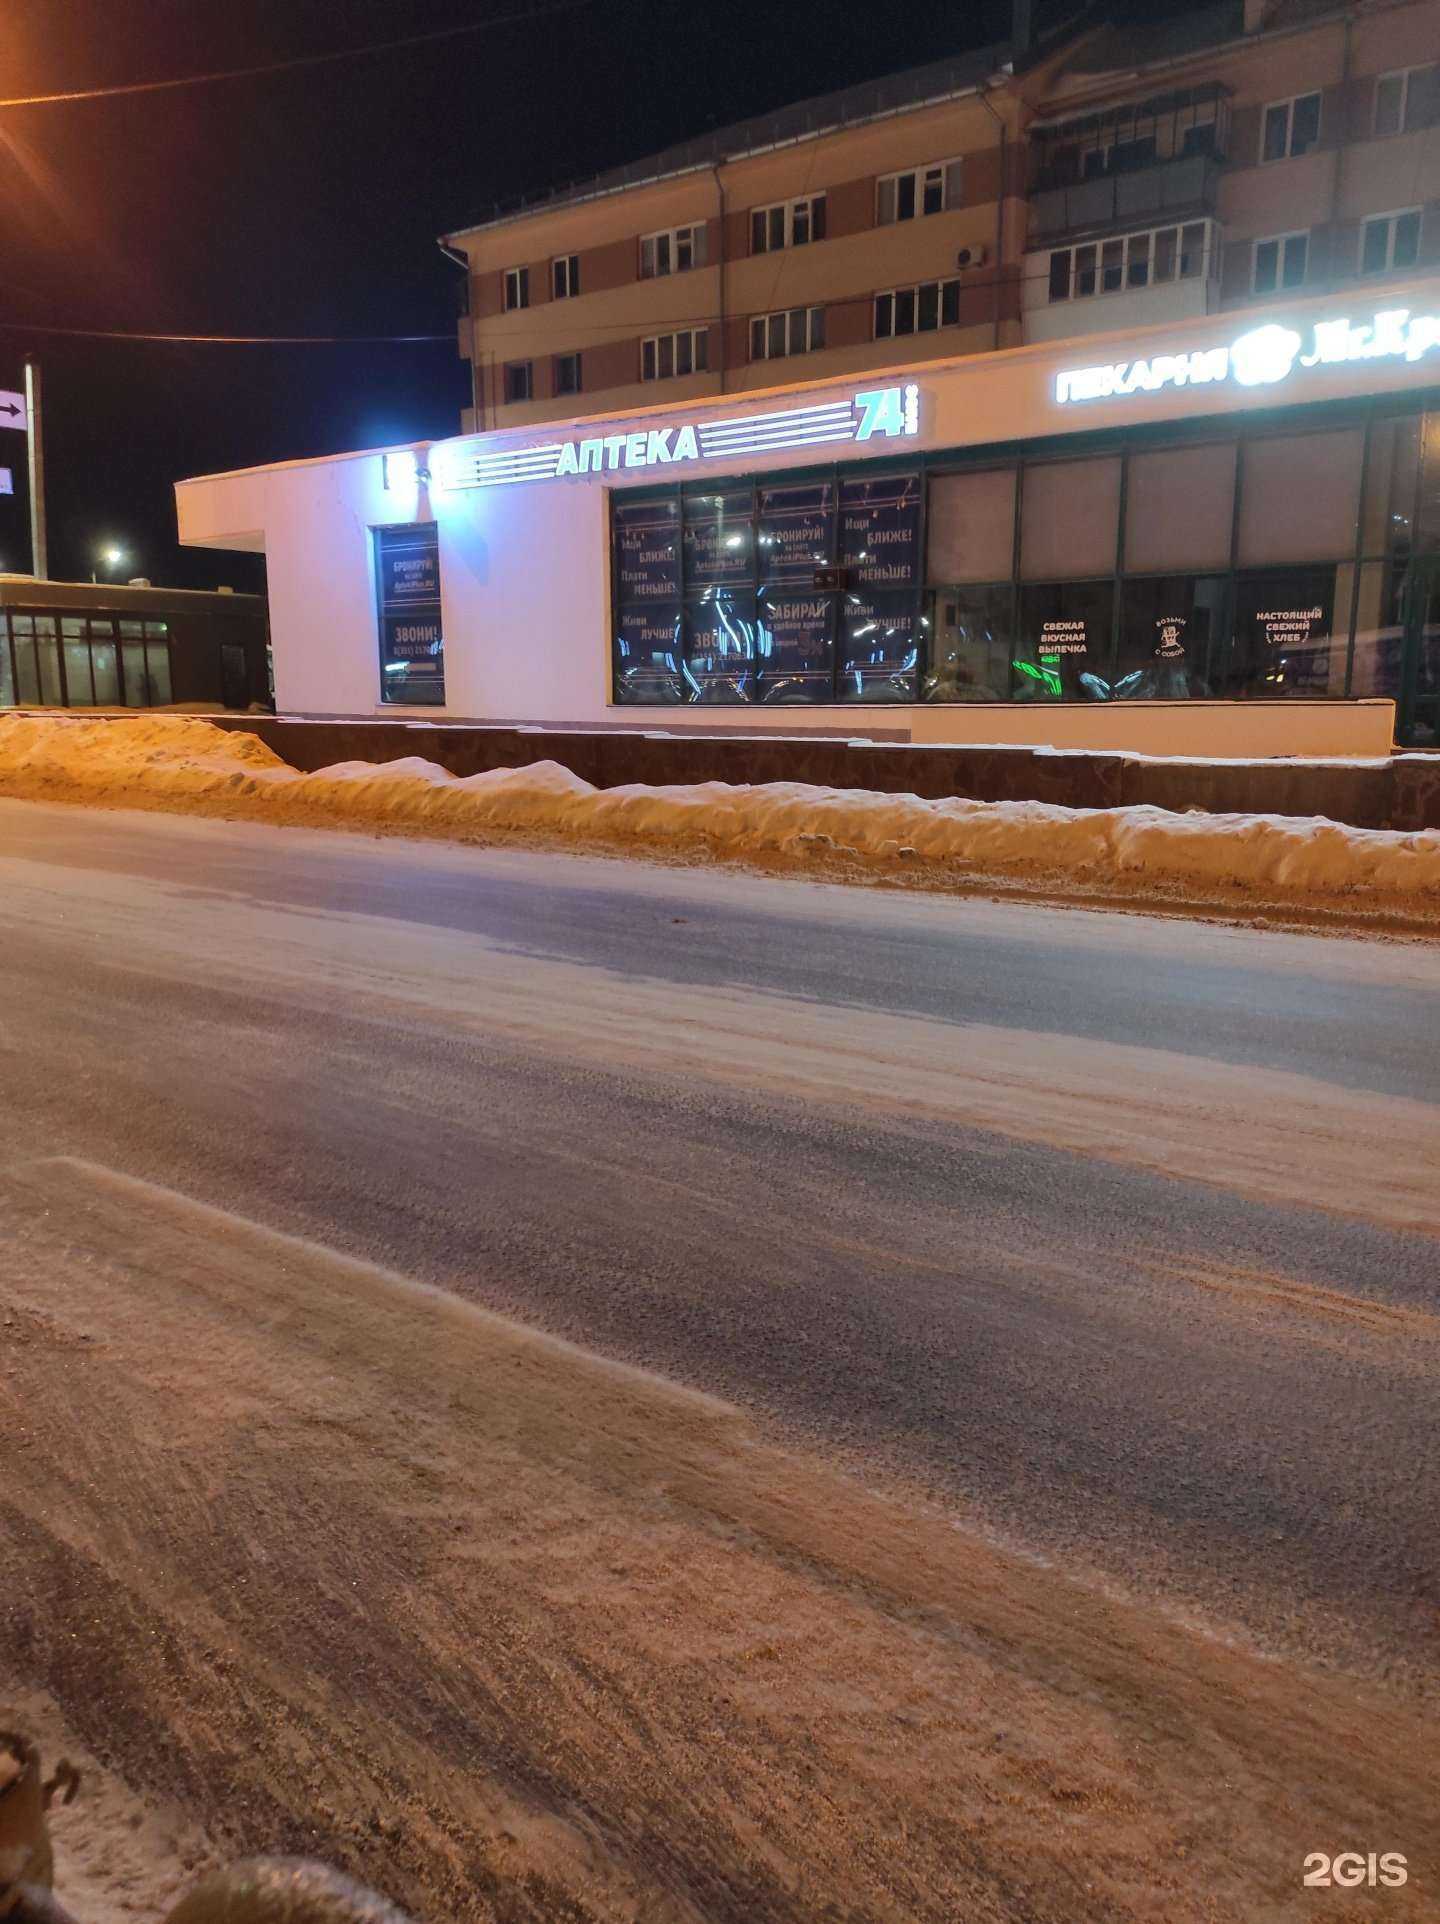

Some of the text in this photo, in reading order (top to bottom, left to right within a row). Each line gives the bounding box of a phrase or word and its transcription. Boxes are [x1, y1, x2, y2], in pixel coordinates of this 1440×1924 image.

[555, 425, 699, 476] АПТЕКА
[854, 387, 905, 441] 74
[866, 529, 912, 546] БЛИЖЕ!
[858, 564, 911, 582] МЕНЬШЕ!
[1256, 607, 1323, 620] НАСТОЯЩИЙ
[1043, 621, 1085, 631] СВЕЖАЯ
[1266, 620, 1310, 631] СВЕЖИЙ
[395, 626, 438, 643] ЗВОНИ!
[641, 628, 675, 640] ЛУЧШЕ
[1040, 633, 1086, 643] ВКУСНАЯ
[1273, 633, 1301, 642] ХЛЕБ
[1038, 644, 1088, 654] ВЫПЕЧКА
